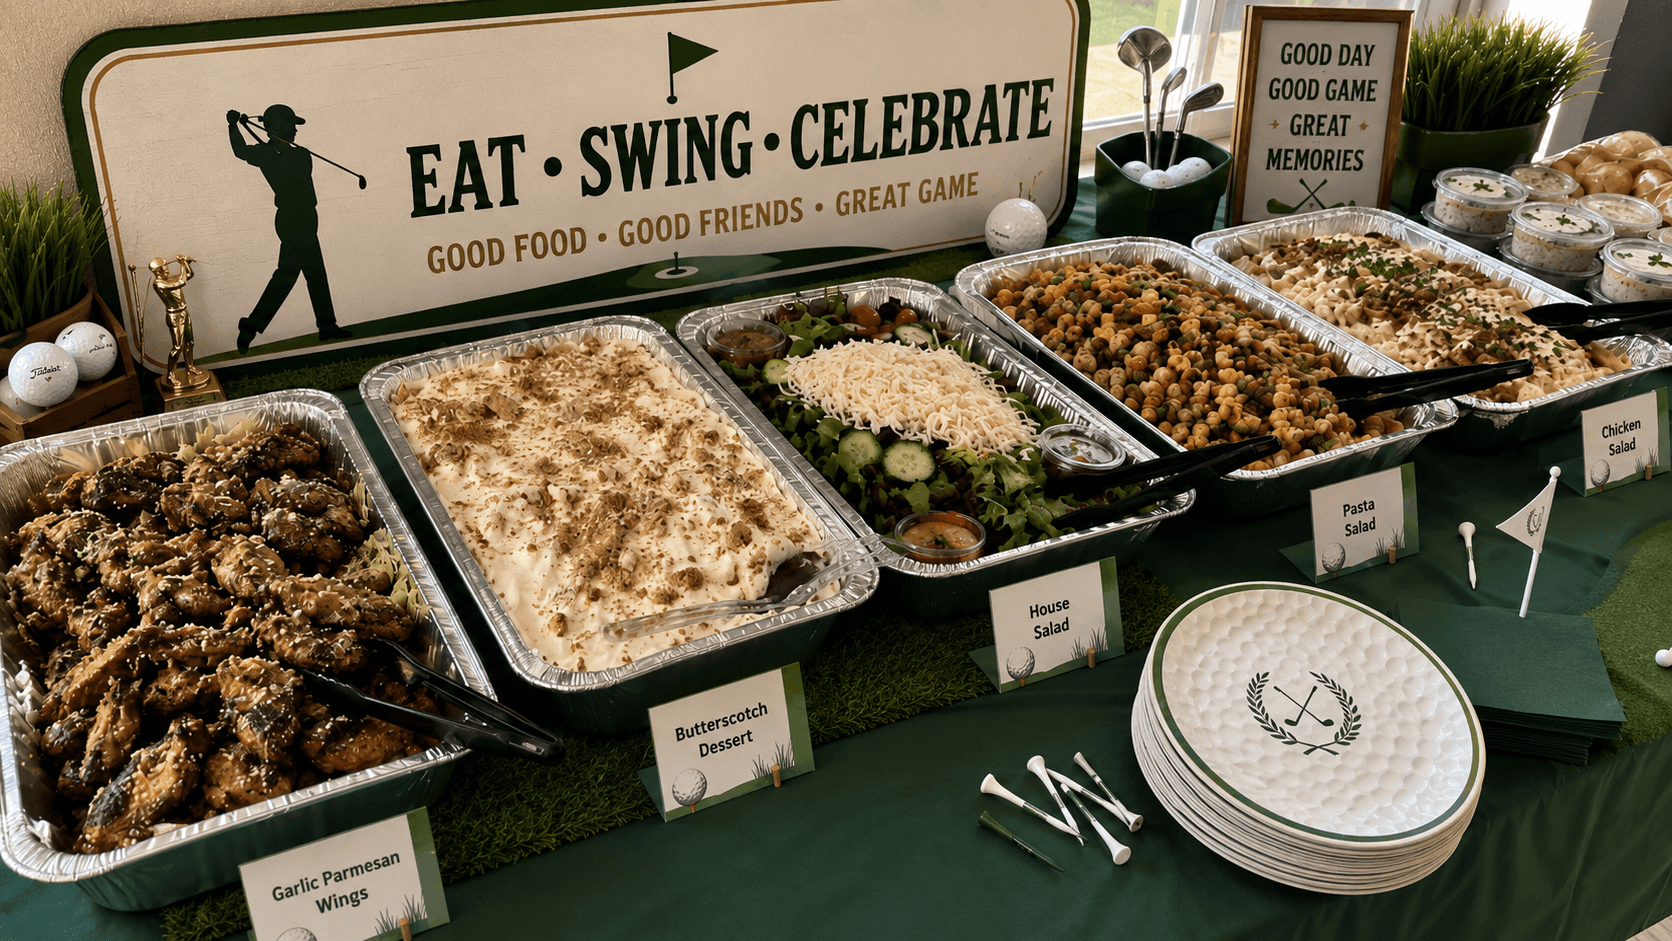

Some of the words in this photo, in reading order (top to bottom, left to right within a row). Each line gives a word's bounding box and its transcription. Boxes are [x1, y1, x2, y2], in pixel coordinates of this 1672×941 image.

[1281, 42, 1332, 66] GOOD
[1338, 44, 1375, 67] DAY
[1269, 78, 1319, 101] GOOD
[1325, 79, 1378, 102] GAME
[1289, 113, 1351, 137] GREAT
[406, 134, 525, 218] EAT
[580, 111, 753, 197] SWING
[791, 78, 1054, 170] CELEBRATE
[1266, 148, 1364, 172] MEMORIES
[427, 237, 505, 274] GOOD
[514, 226, 587, 262] FOOD
[619, 212, 690, 247] GOOD
[700, 197, 803, 236] FRIENDS
[836, 182, 910, 217] GREAT
[918, 172, 979, 204] GAME
[1602, 420, 1641, 438] Chicken
[1609, 437, 1636, 456] Salad
[1343, 500, 1375, 517] Pasta
[1345, 516, 1376, 537] Salad
[1030, 599, 1070, 619] House
[1034, 617, 1070, 640] Salad
[675, 702, 768, 742] Butterscotch
[699, 730, 753, 758] Dessert
[272, 877, 320, 901] Garlic
[322, 853, 401, 886] Parmesan
[315, 888, 369, 914] Wings
